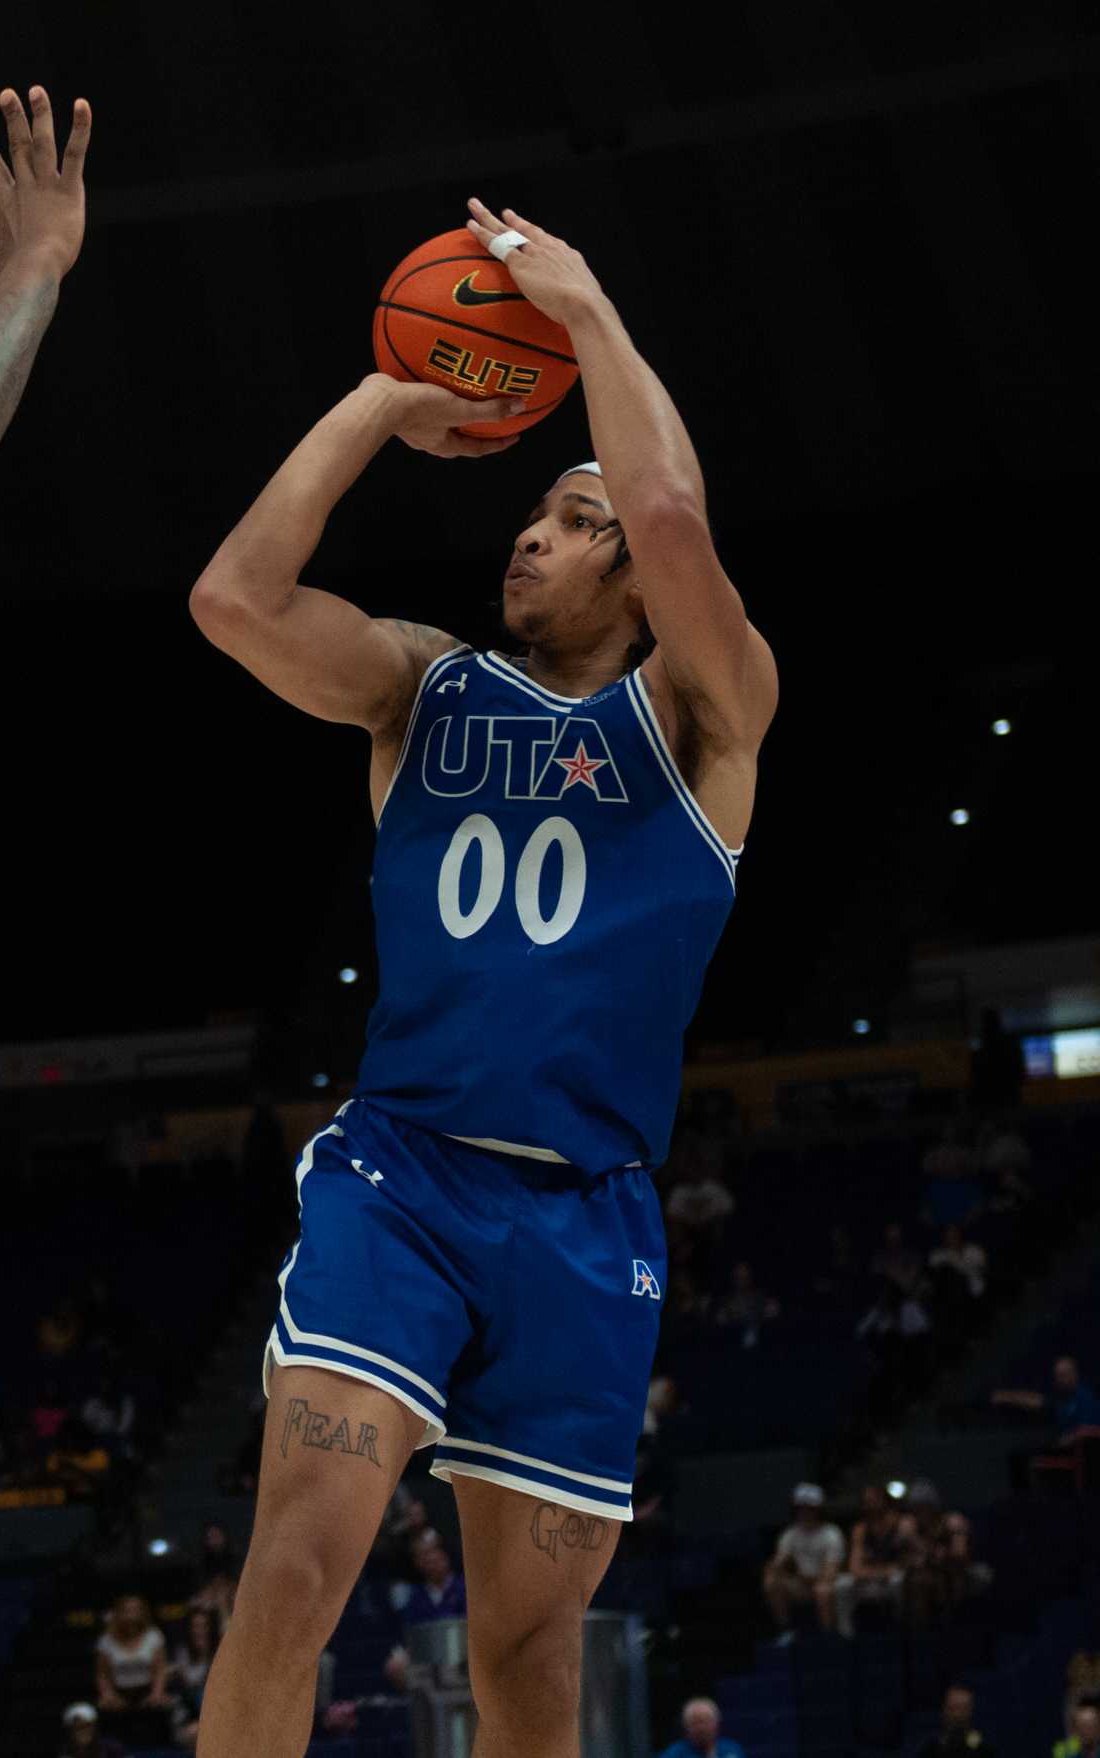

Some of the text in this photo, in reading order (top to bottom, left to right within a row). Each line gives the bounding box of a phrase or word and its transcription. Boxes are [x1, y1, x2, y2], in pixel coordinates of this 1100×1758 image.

[427, 338, 542, 395] ELITE
[422, 714, 629, 803] UTA
[438, 813, 587, 946] 00
